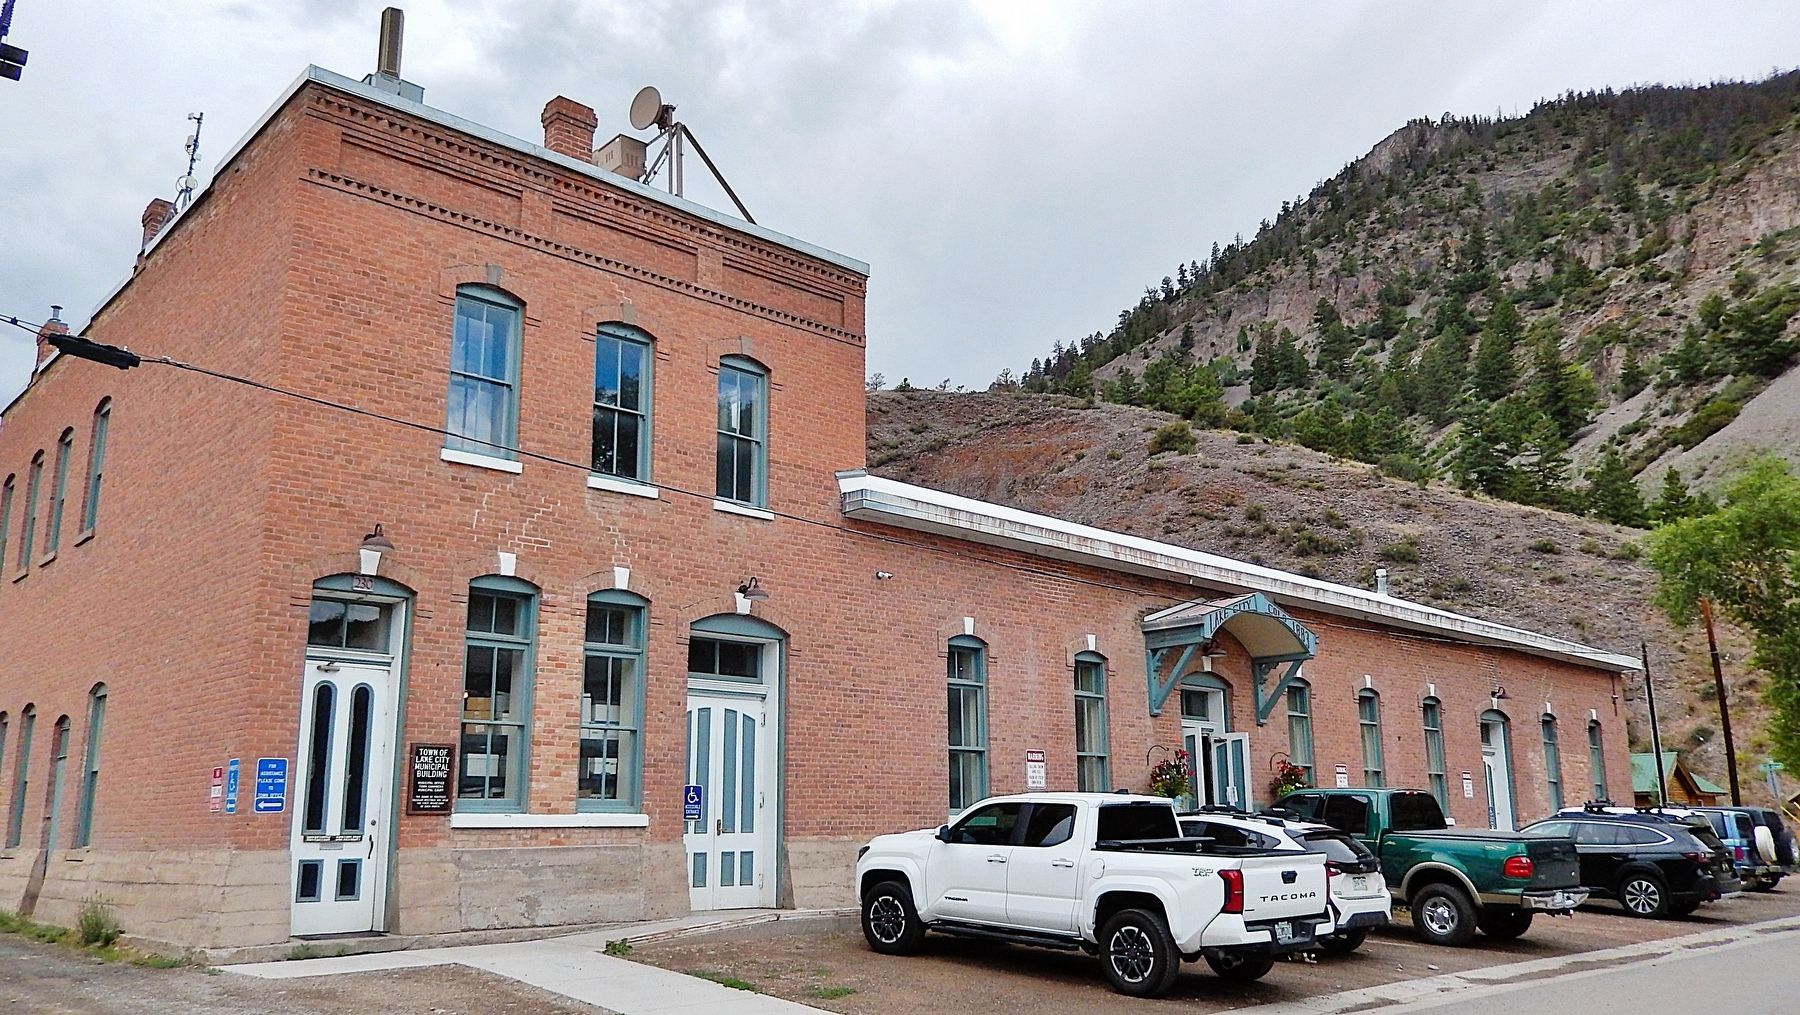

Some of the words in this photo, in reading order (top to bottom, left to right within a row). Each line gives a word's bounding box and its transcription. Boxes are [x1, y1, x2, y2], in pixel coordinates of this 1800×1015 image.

[354, 577, 373, 589] 230
[1209, 609, 1229, 634] LAKE
[1232, 599, 1252, 614] CITY
[1292, 621, 1310, 649] 1883
[419, 748, 439, 756] TOWN
[414, 763, 450, 771] MUNICIPAL
[1260, 891, 1316, 902] TACOMA
